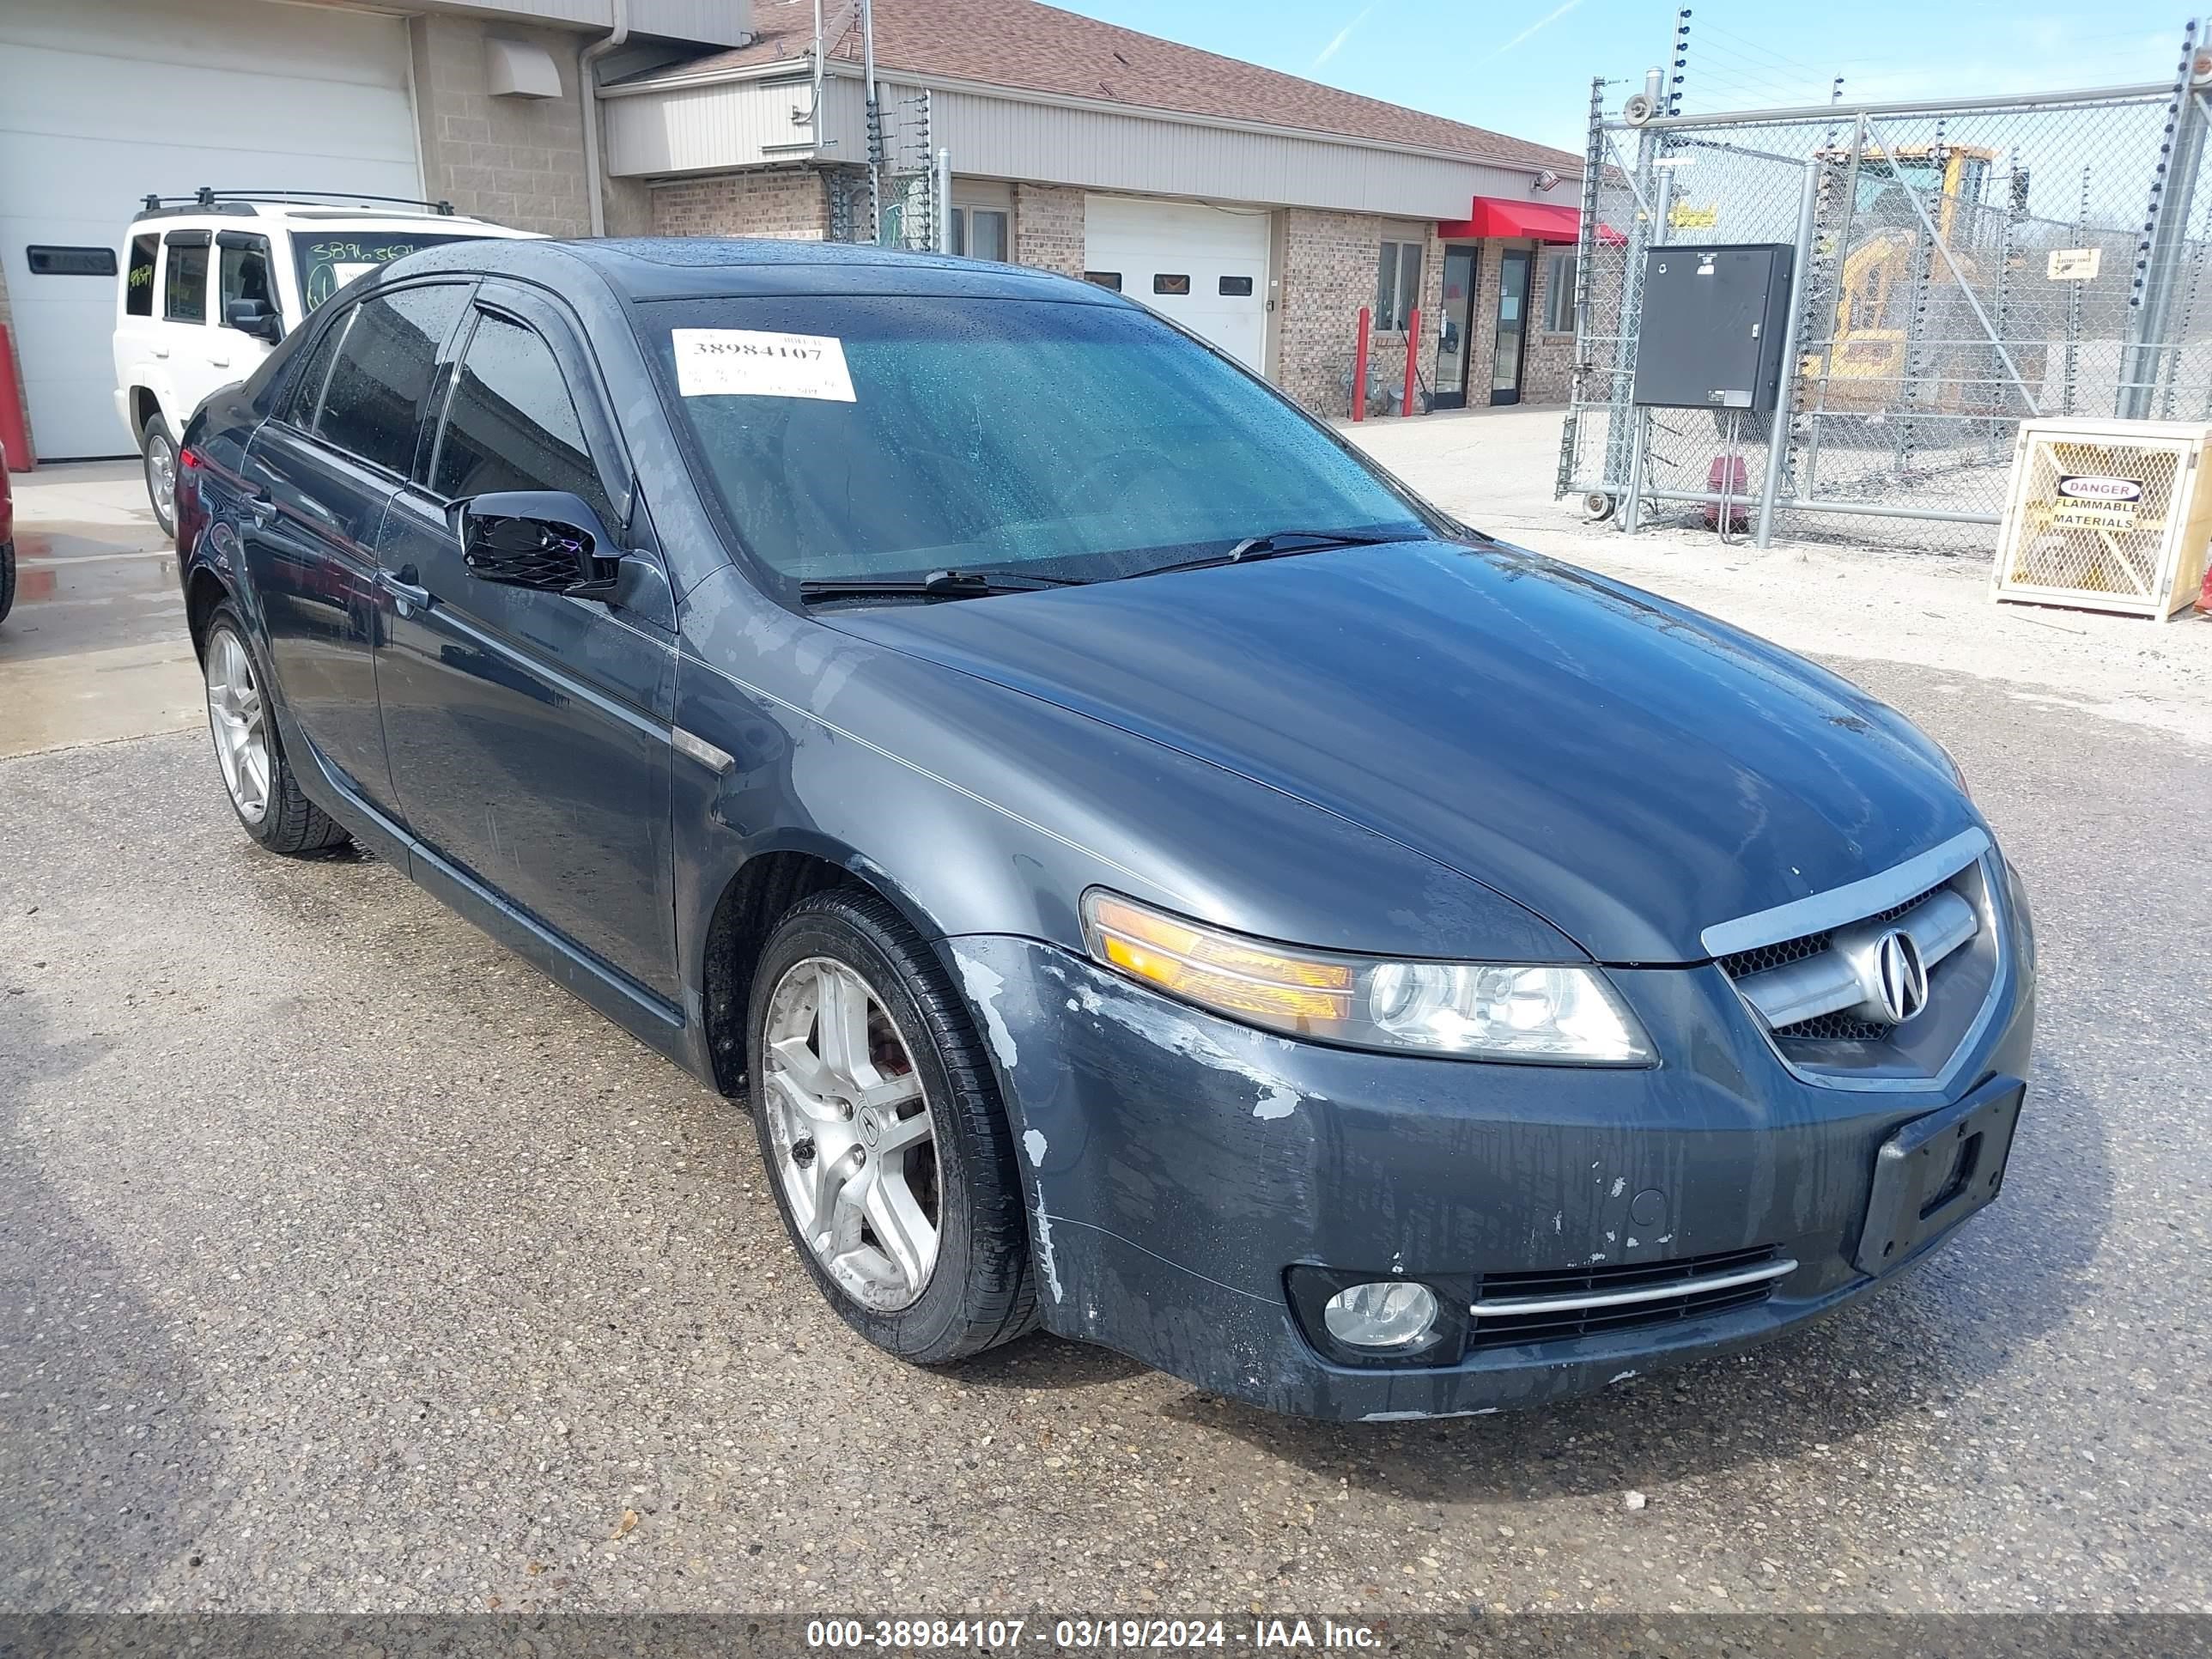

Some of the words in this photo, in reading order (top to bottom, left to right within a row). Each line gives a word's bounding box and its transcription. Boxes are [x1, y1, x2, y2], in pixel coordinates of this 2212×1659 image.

[693, 343, 822, 361] 38984107
[2069, 482, 2130, 495] DANGER
[2055, 498, 2140, 513] FLAMMABLE
[2053, 514, 2134, 529] MATERIALS
